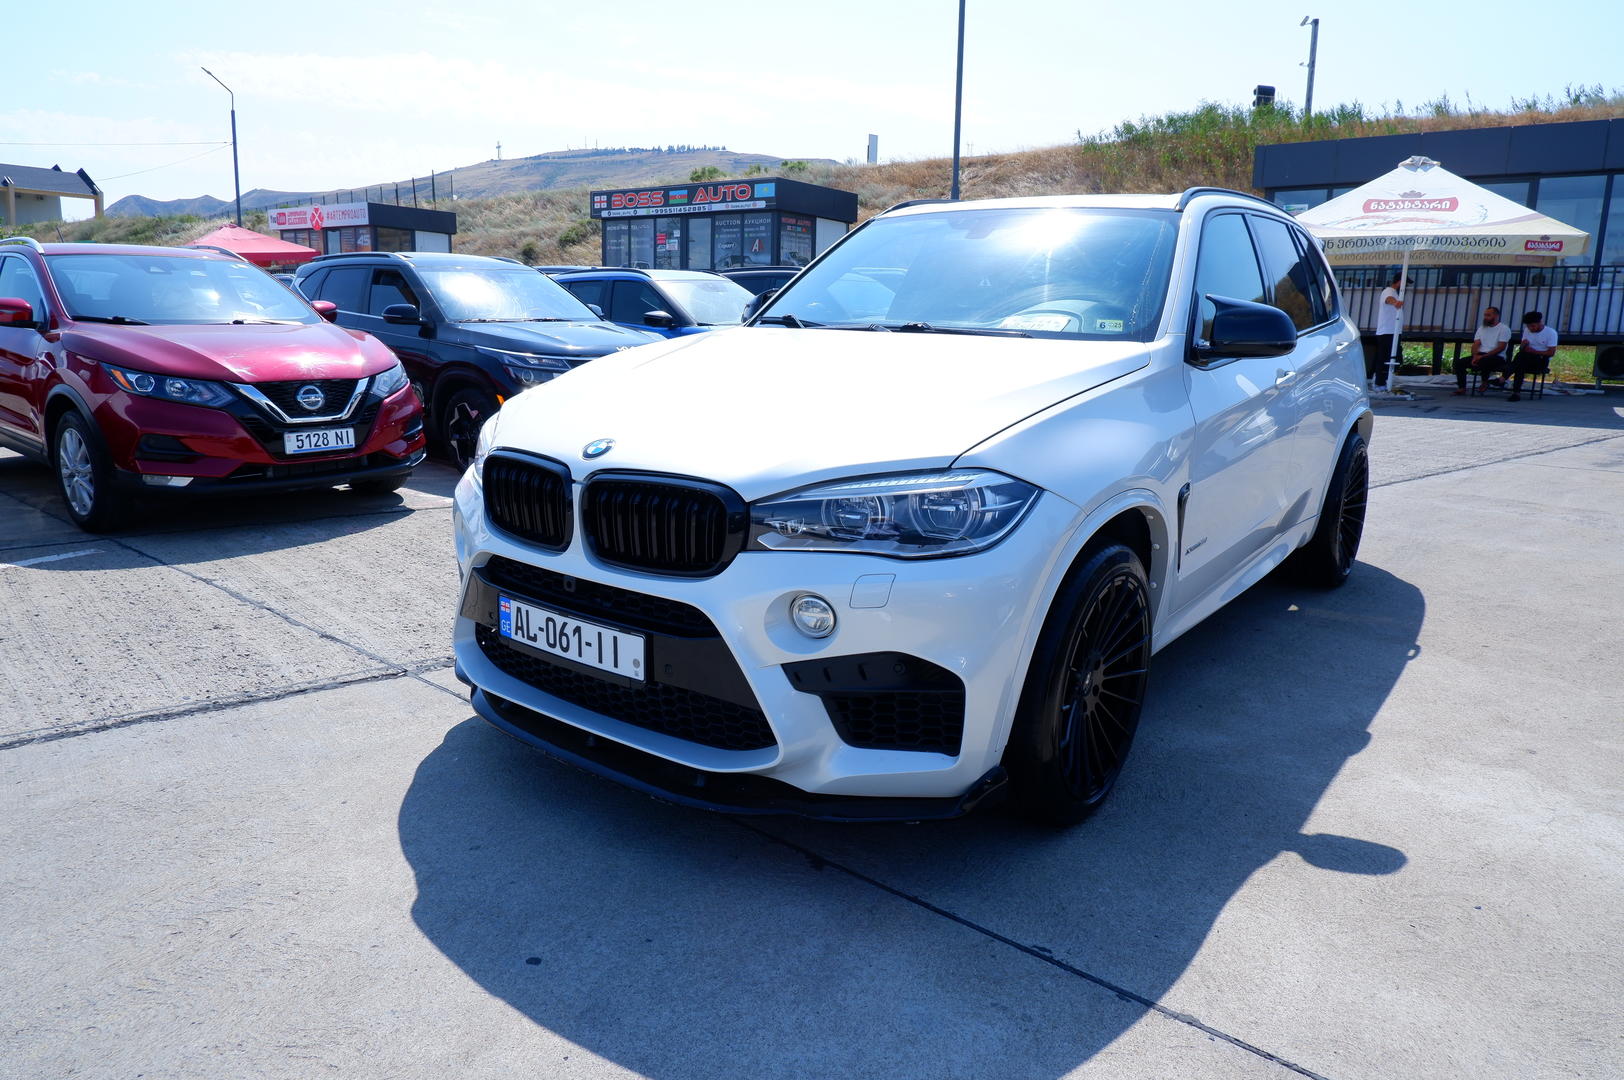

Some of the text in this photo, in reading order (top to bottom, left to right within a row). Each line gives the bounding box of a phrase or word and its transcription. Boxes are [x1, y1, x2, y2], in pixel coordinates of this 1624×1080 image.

[611, 184, 751, 208] BOSS AUTO
[1370, 200, 1451, 210] ნატახტარი
[1431, 235, 1506, 248] მთავარია
[296, 430, 350, 449] 5128 NI
[501, 619, 511, 633] GE
